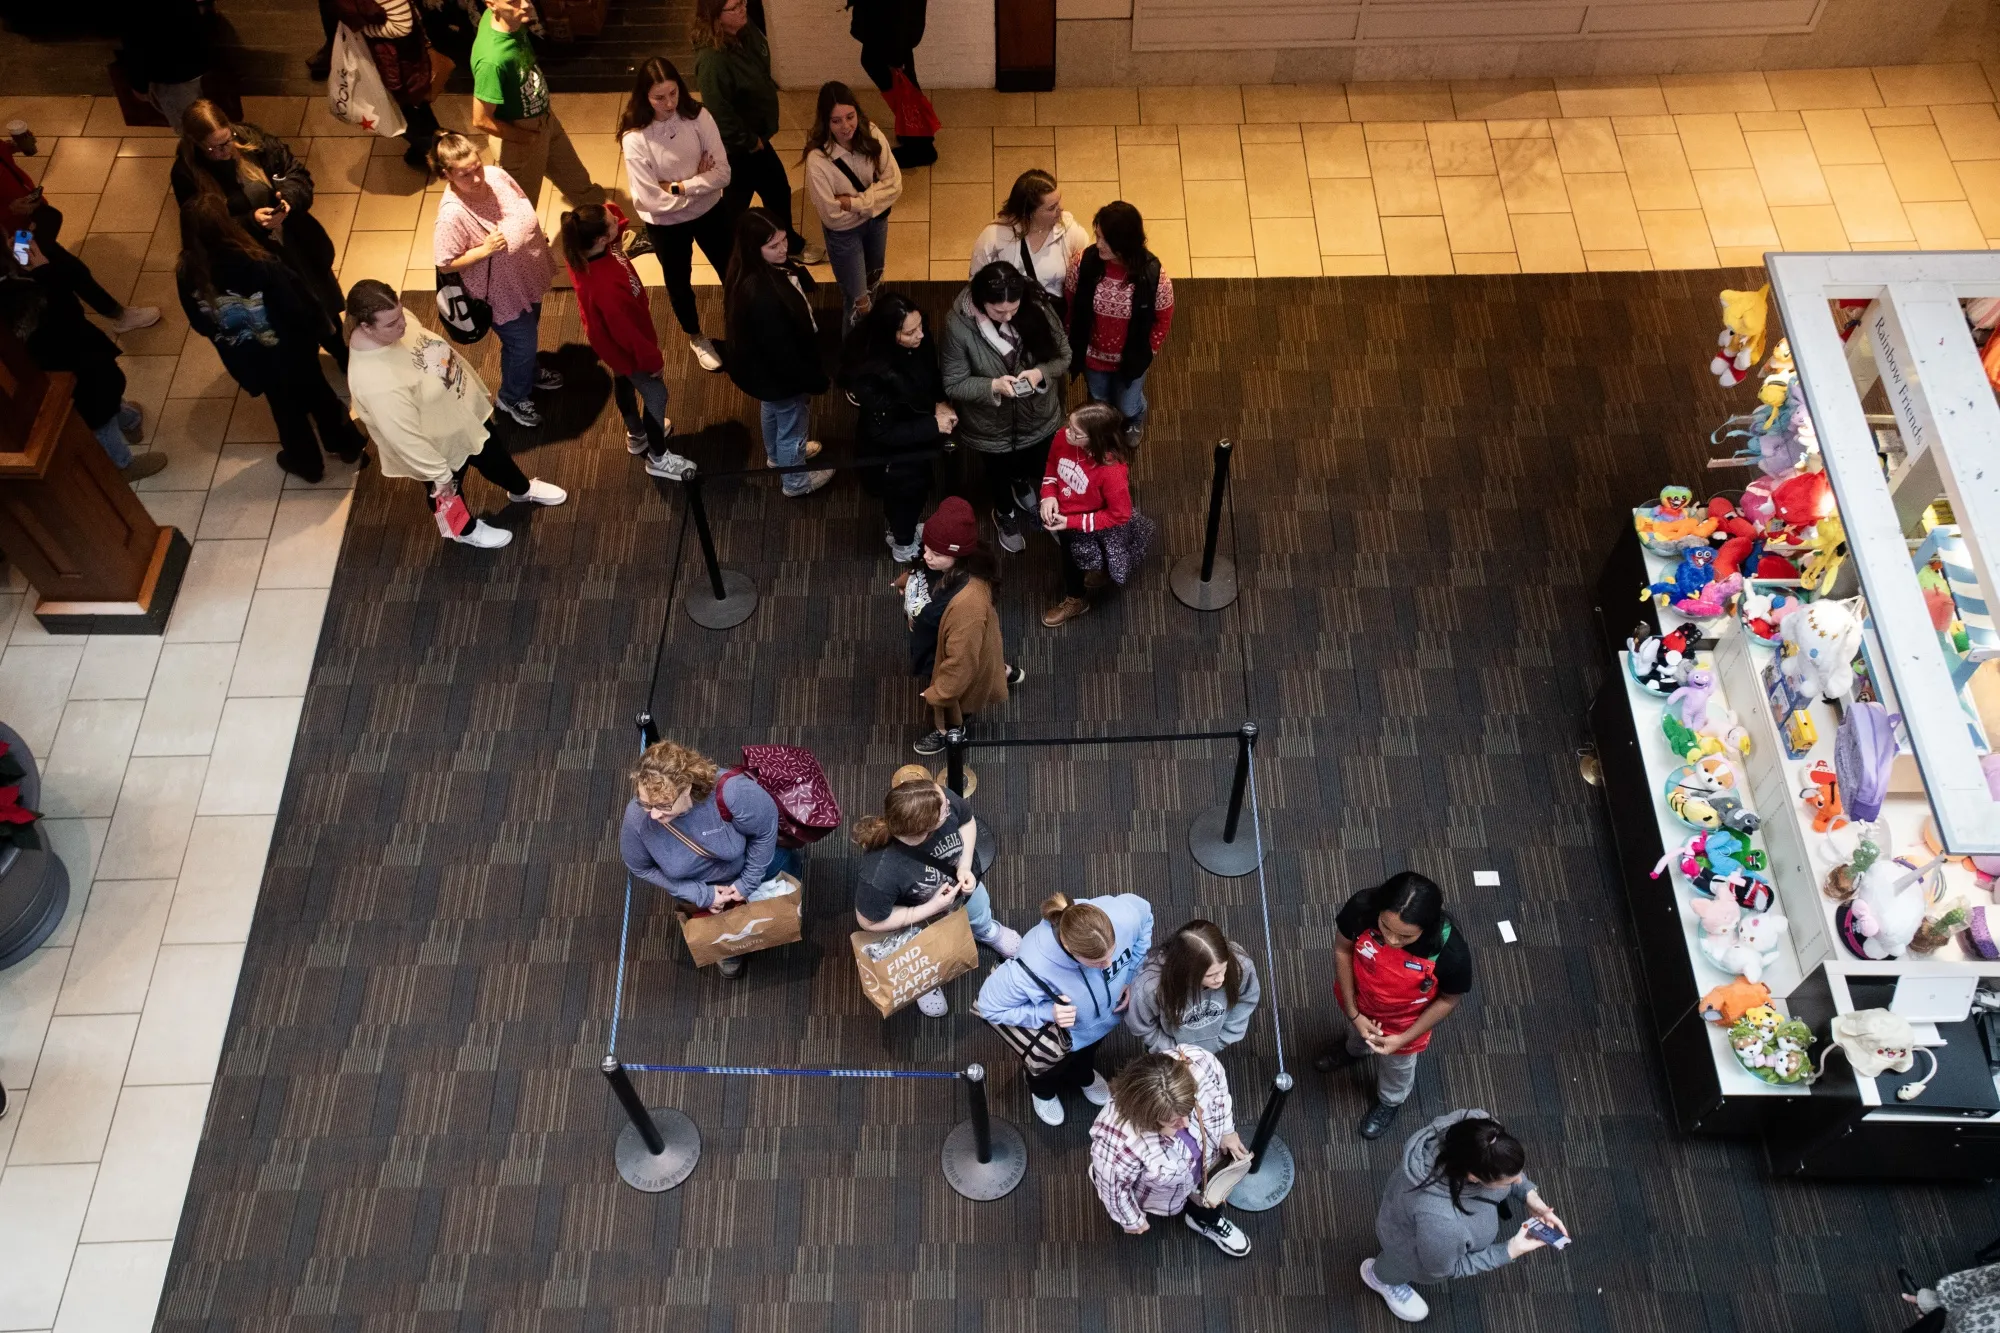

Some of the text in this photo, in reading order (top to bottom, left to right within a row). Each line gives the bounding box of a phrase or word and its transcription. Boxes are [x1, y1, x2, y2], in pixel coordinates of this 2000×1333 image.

[448, 295, 471, 321] JD
[1875, 316, 1924, 446] Rainbow Friends
[887, 945, 921, 975] FIND
[888, 955, 930, 986] YOUR
[892, 961, 941, 998] HAPPY
[893, 975, 943, 1008] PLACE.
